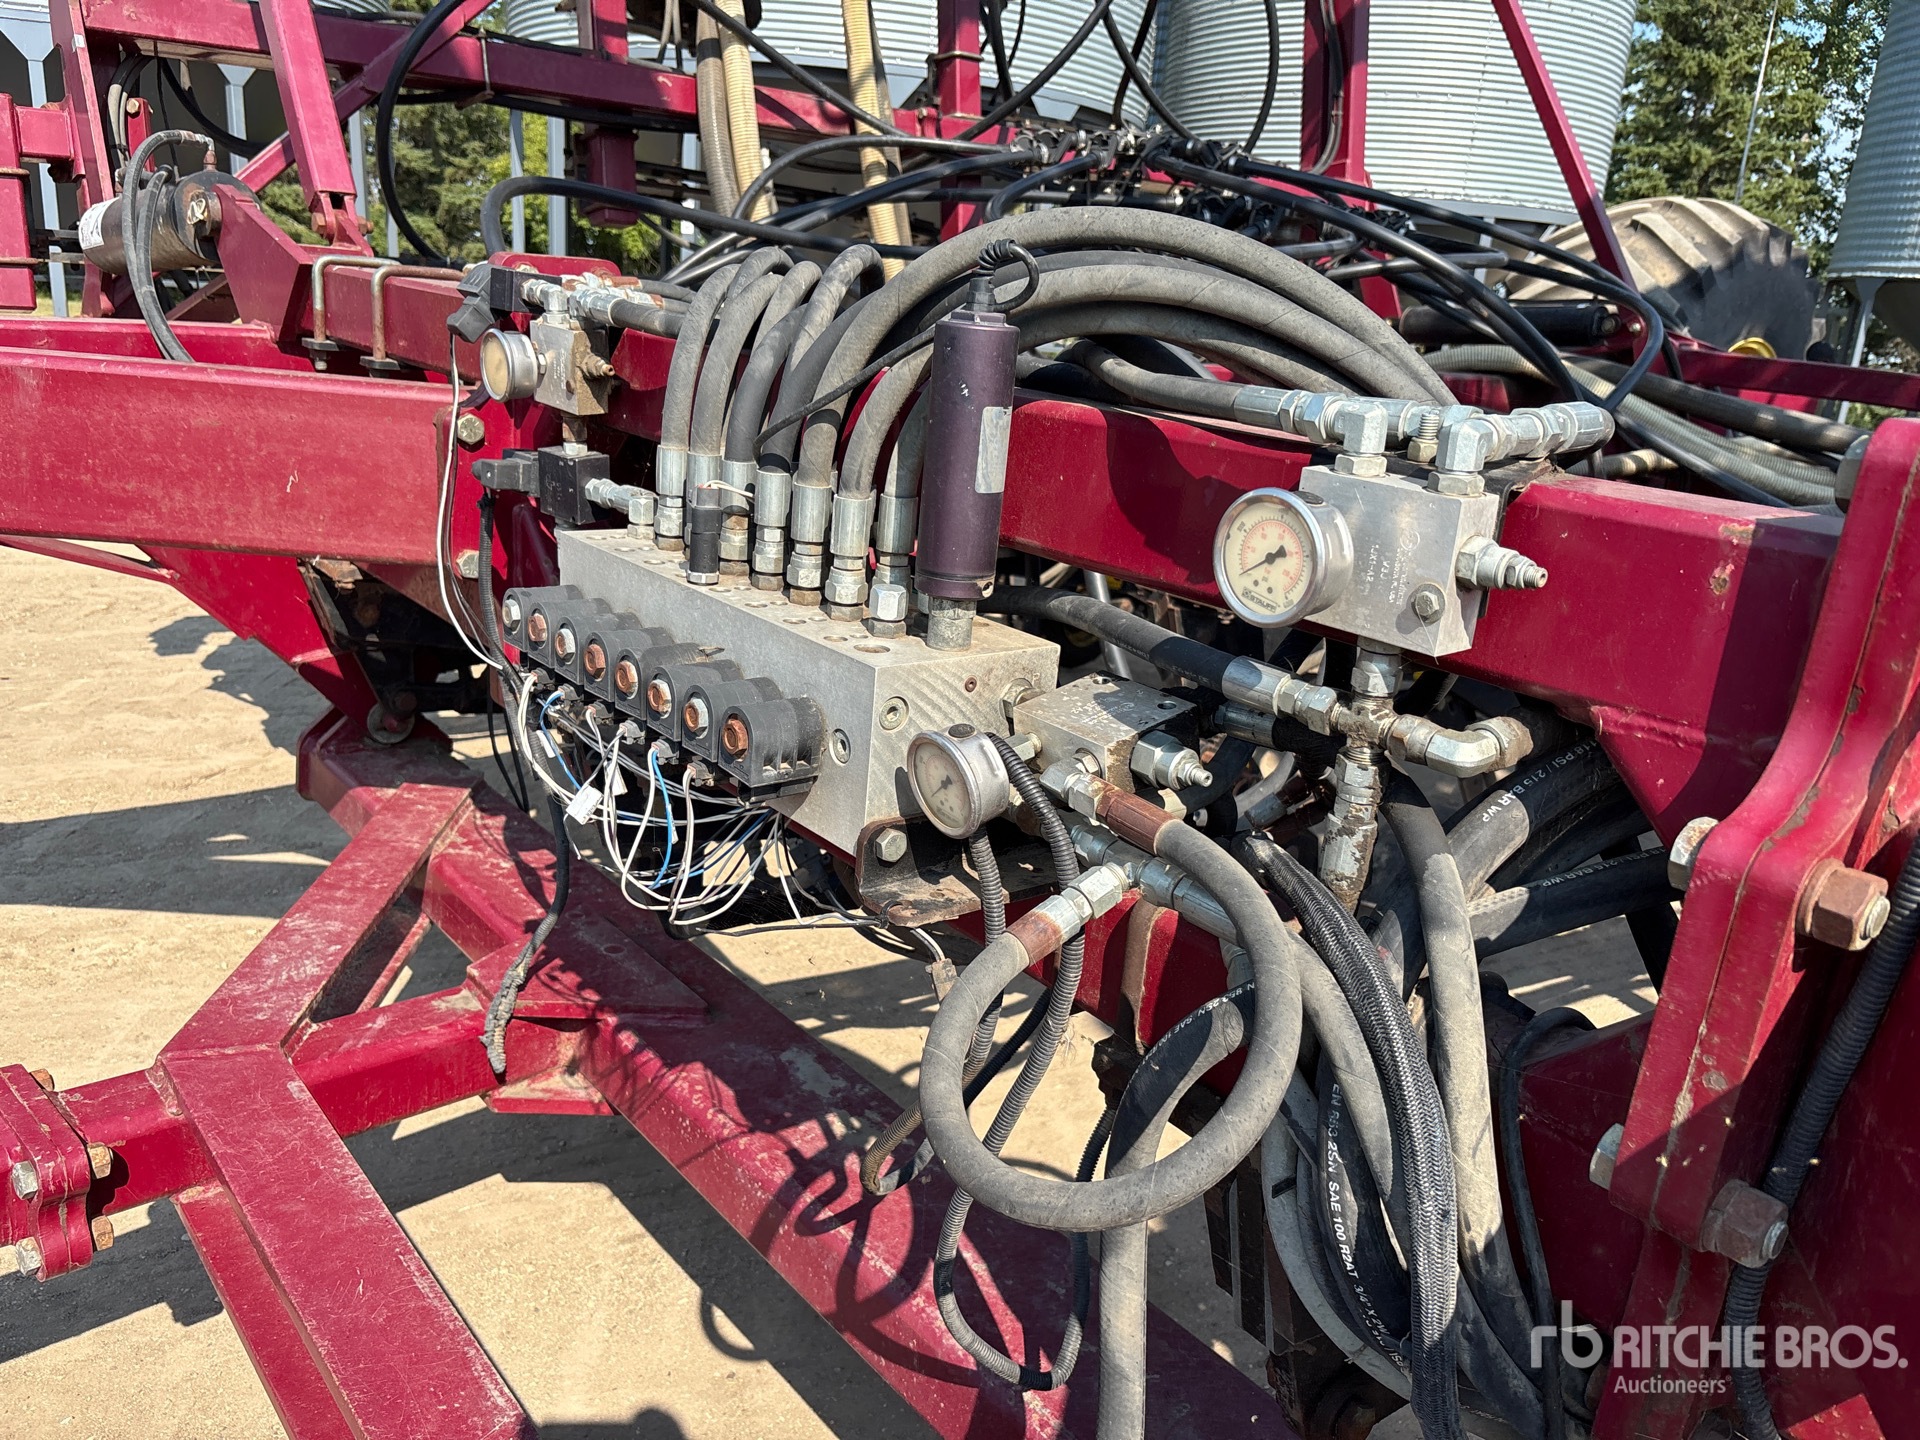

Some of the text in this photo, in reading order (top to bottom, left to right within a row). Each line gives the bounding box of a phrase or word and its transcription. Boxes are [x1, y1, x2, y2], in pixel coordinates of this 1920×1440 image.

[1249, 594, 1278, 613] STAUFF
[1552, 752, 1575, 768] PSI
[1523, 769, 1546, 787] 215
[1497, 785, 1526, 806] BAR
[1482, 805, 1502, 822] WP
[1542, 876, 1565, 887] WP
[1565, 867, 1594, 880] BAR
[1330, 1083, 1342, 1106] EN
[1327, 1140, 1338, 1173] 2SN
[1328, 1181, 1342, 1212] SAE
[1331, 1216, 1347, 1240] 100
[1340, 1244, 1359, 1279] R2AT
